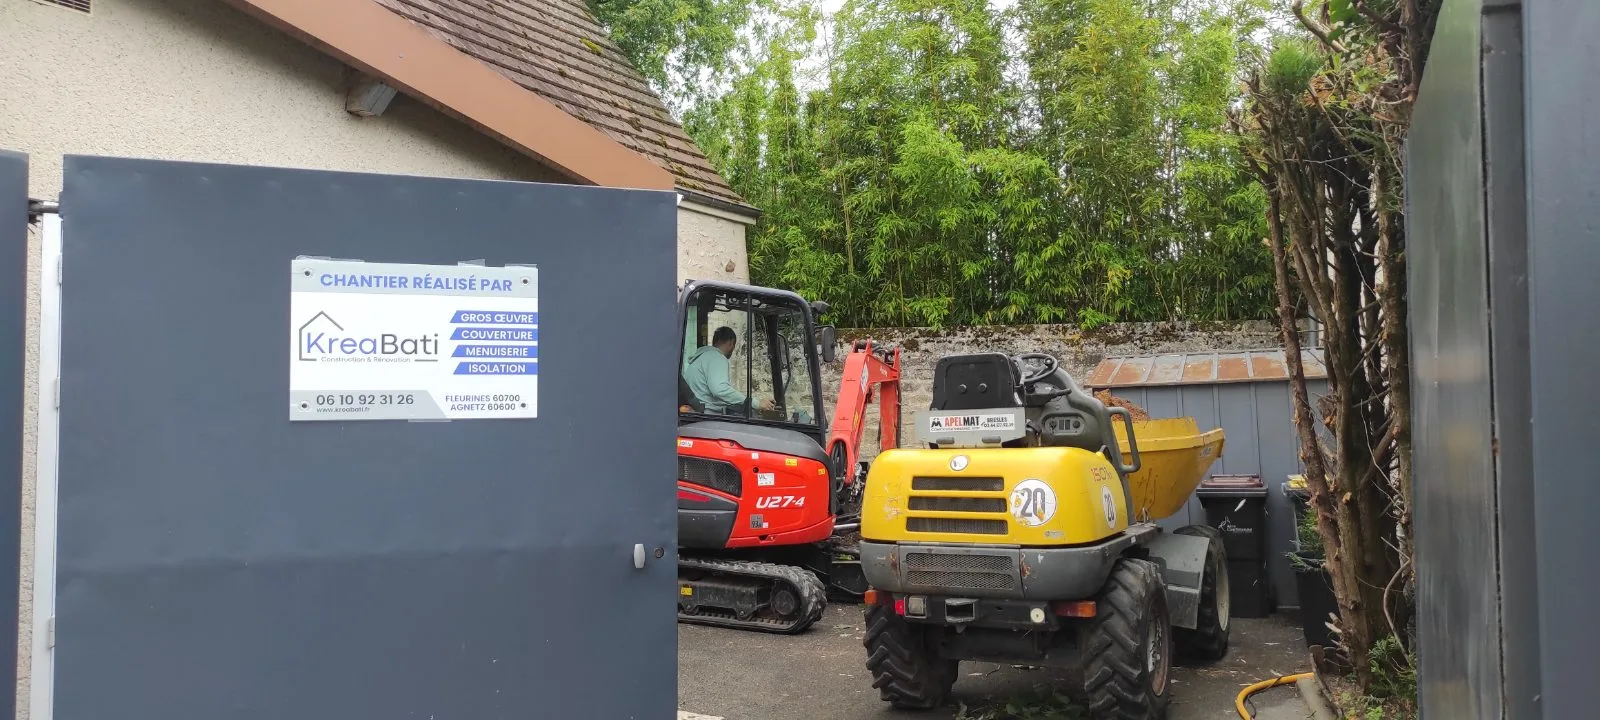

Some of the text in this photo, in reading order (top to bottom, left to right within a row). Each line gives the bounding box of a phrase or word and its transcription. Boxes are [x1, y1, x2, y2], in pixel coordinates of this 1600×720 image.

[320, 273, 513, 291] CHANTIER RÉALISÉ PAR
[460, 313, 534, 323] GROS ŒUVRE
[461, 330, 533, 340] COUVERTURE
[306, 332, 439, 355] KreaBati
[465, 347, 528, 357] MENUISERIE
[468, 364, 526, 373] ISOLATION
[316, 394, 414, 405] 06 10 92 31 26
[445, 394, 520, 402] FLEURINES 60700
[450, 403, 516, 411] AGNETZ 60600
[944, 416, 980, 427] APELMAT
[756, 495, 806, 509] U27-4
[1020, 487, 1046, 518] 20
[1103, 493, 1115, 521] 20
